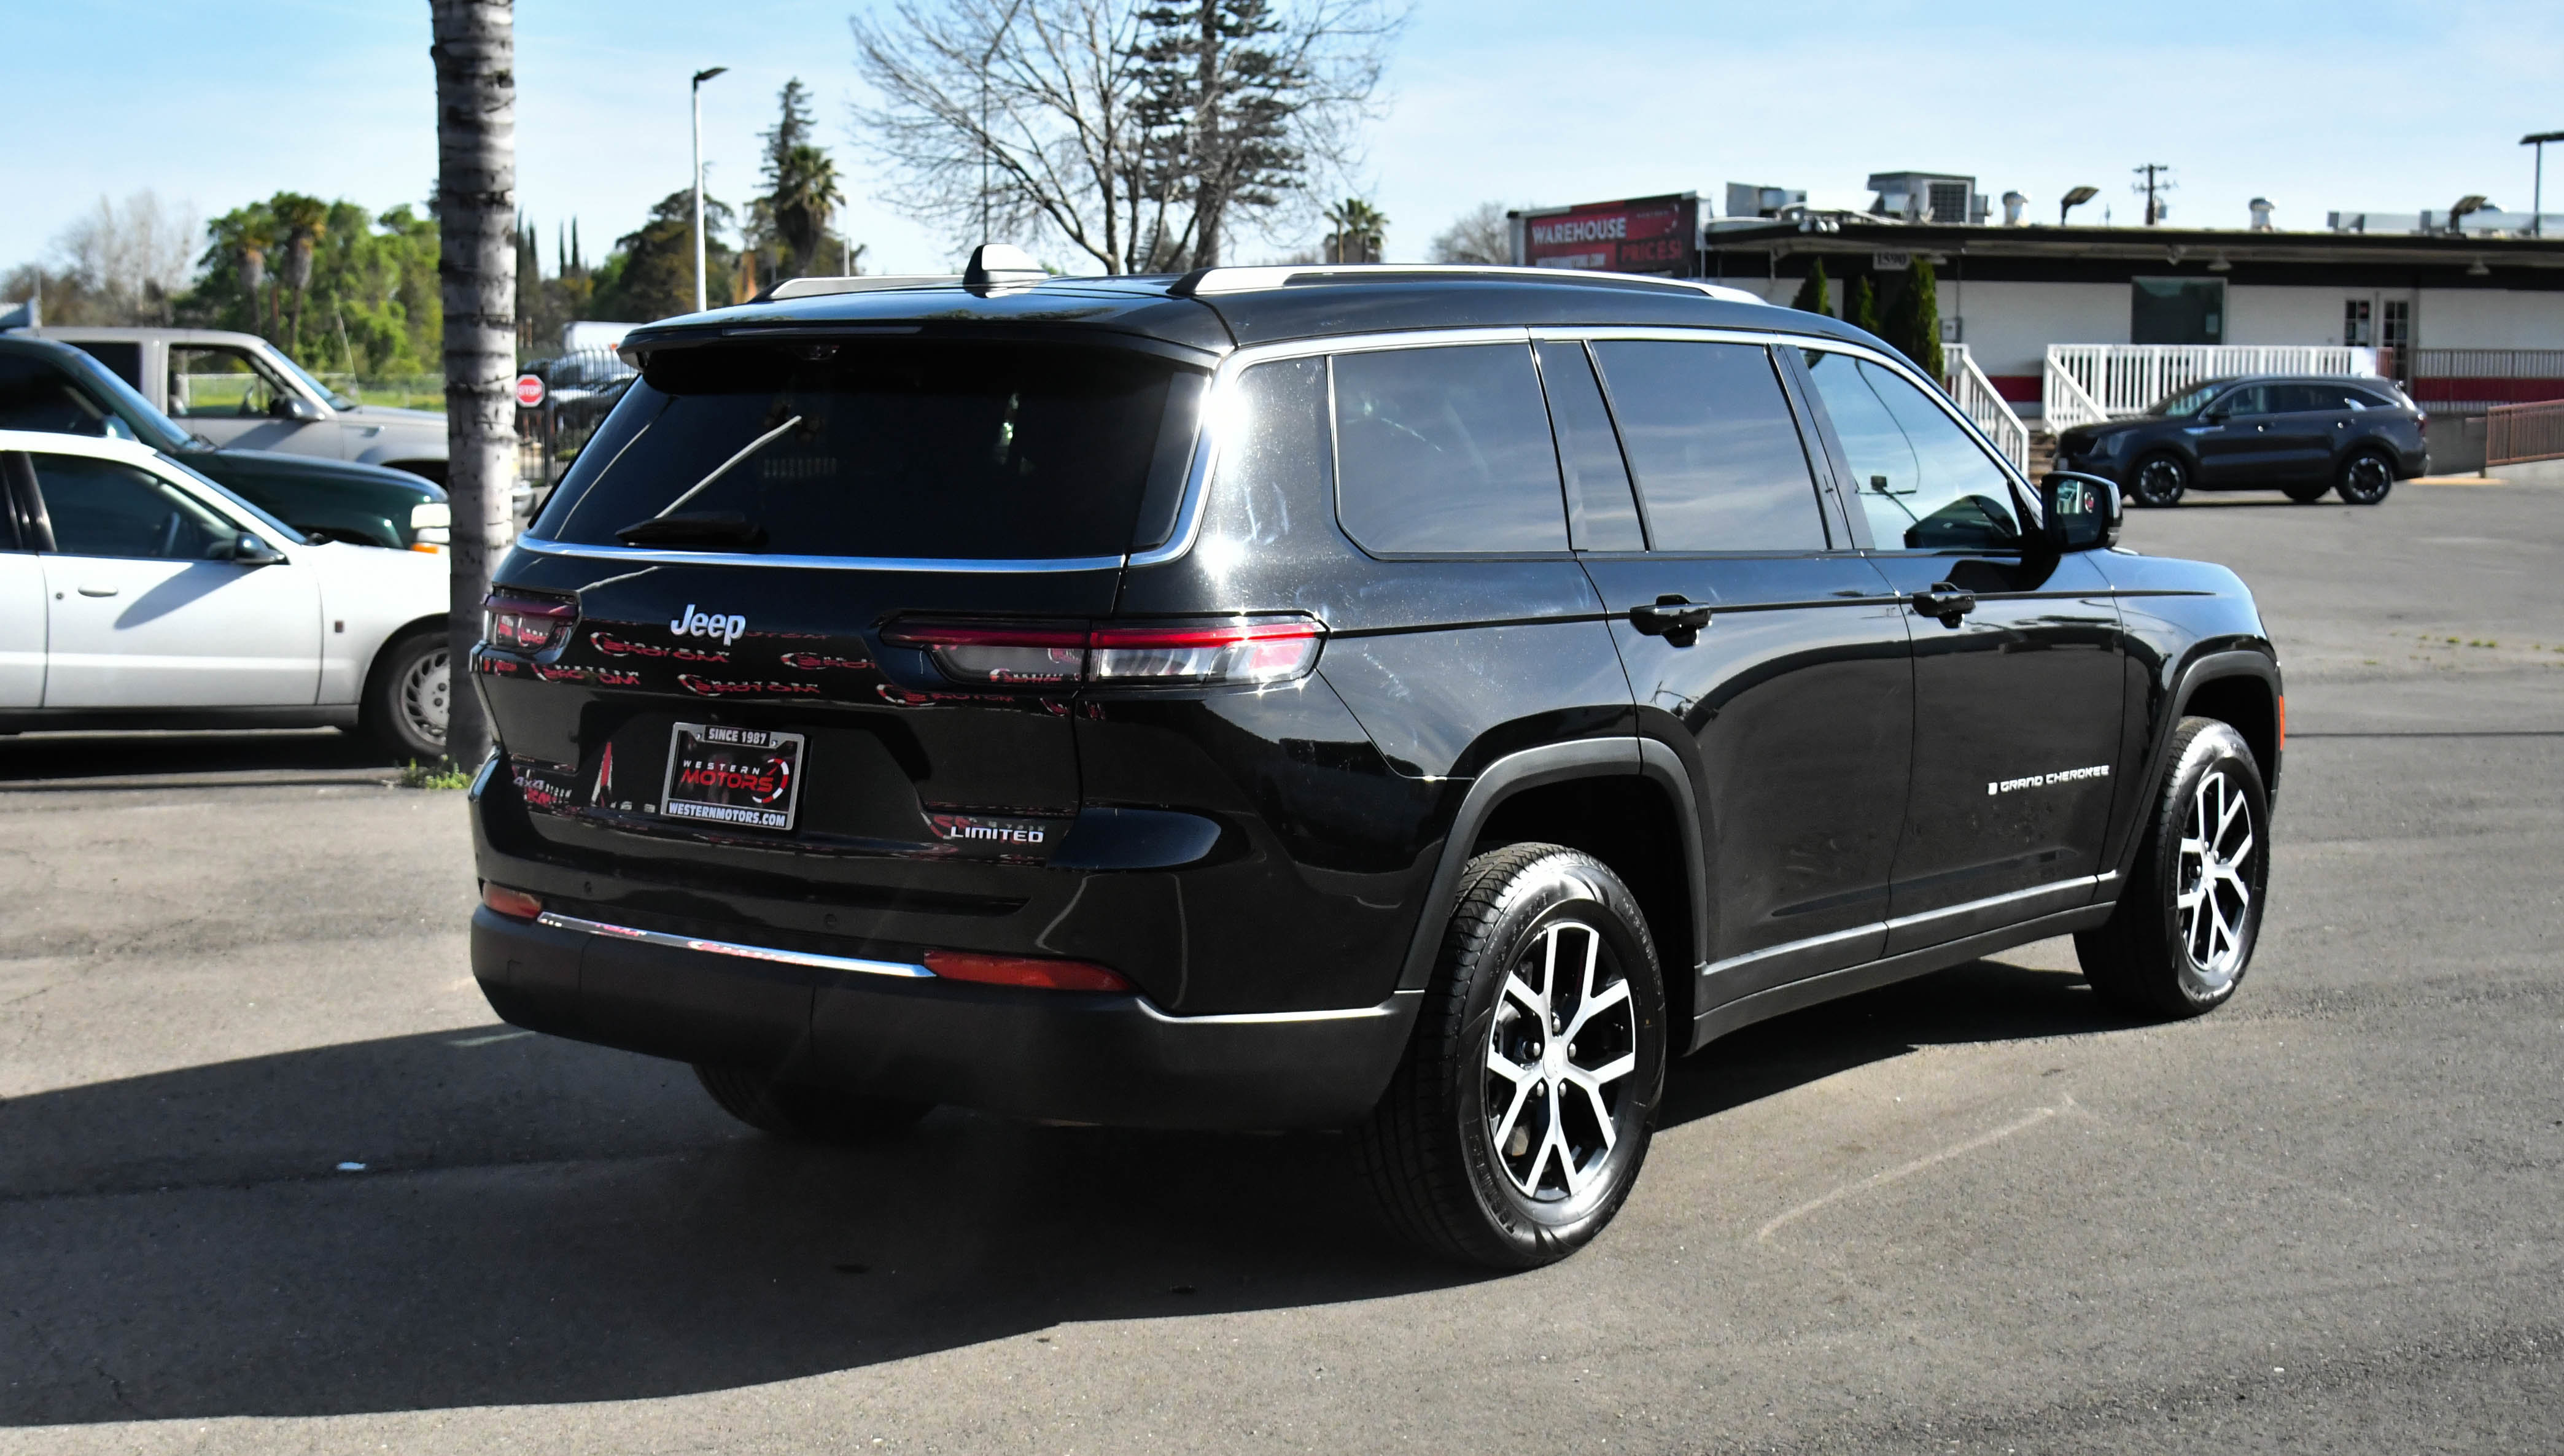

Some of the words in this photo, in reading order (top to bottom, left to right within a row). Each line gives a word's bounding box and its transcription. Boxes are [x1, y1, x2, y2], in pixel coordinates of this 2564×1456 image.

[1533, 217, 1627, 246] WAREHOUSE
[518, 384, 542, 397] STOP
[670, 604, 746, 646] Jeep
[709, 727, 739, 742] SINCE
[742, 731, 767, 745] 1987
[683, 759, 760, 775] WESTERN
[513, 776, 544, 790] 4x4
[680, 768, 774, 793] MOTORS
[2000, 776, 2043, 792] GRAND
[2046, 765, 2110, 784] CHEROKEE
[669, 802, 786, 827] WESTERNMOTORS.COM
[951, 826, 1044, 843] LIMITED
